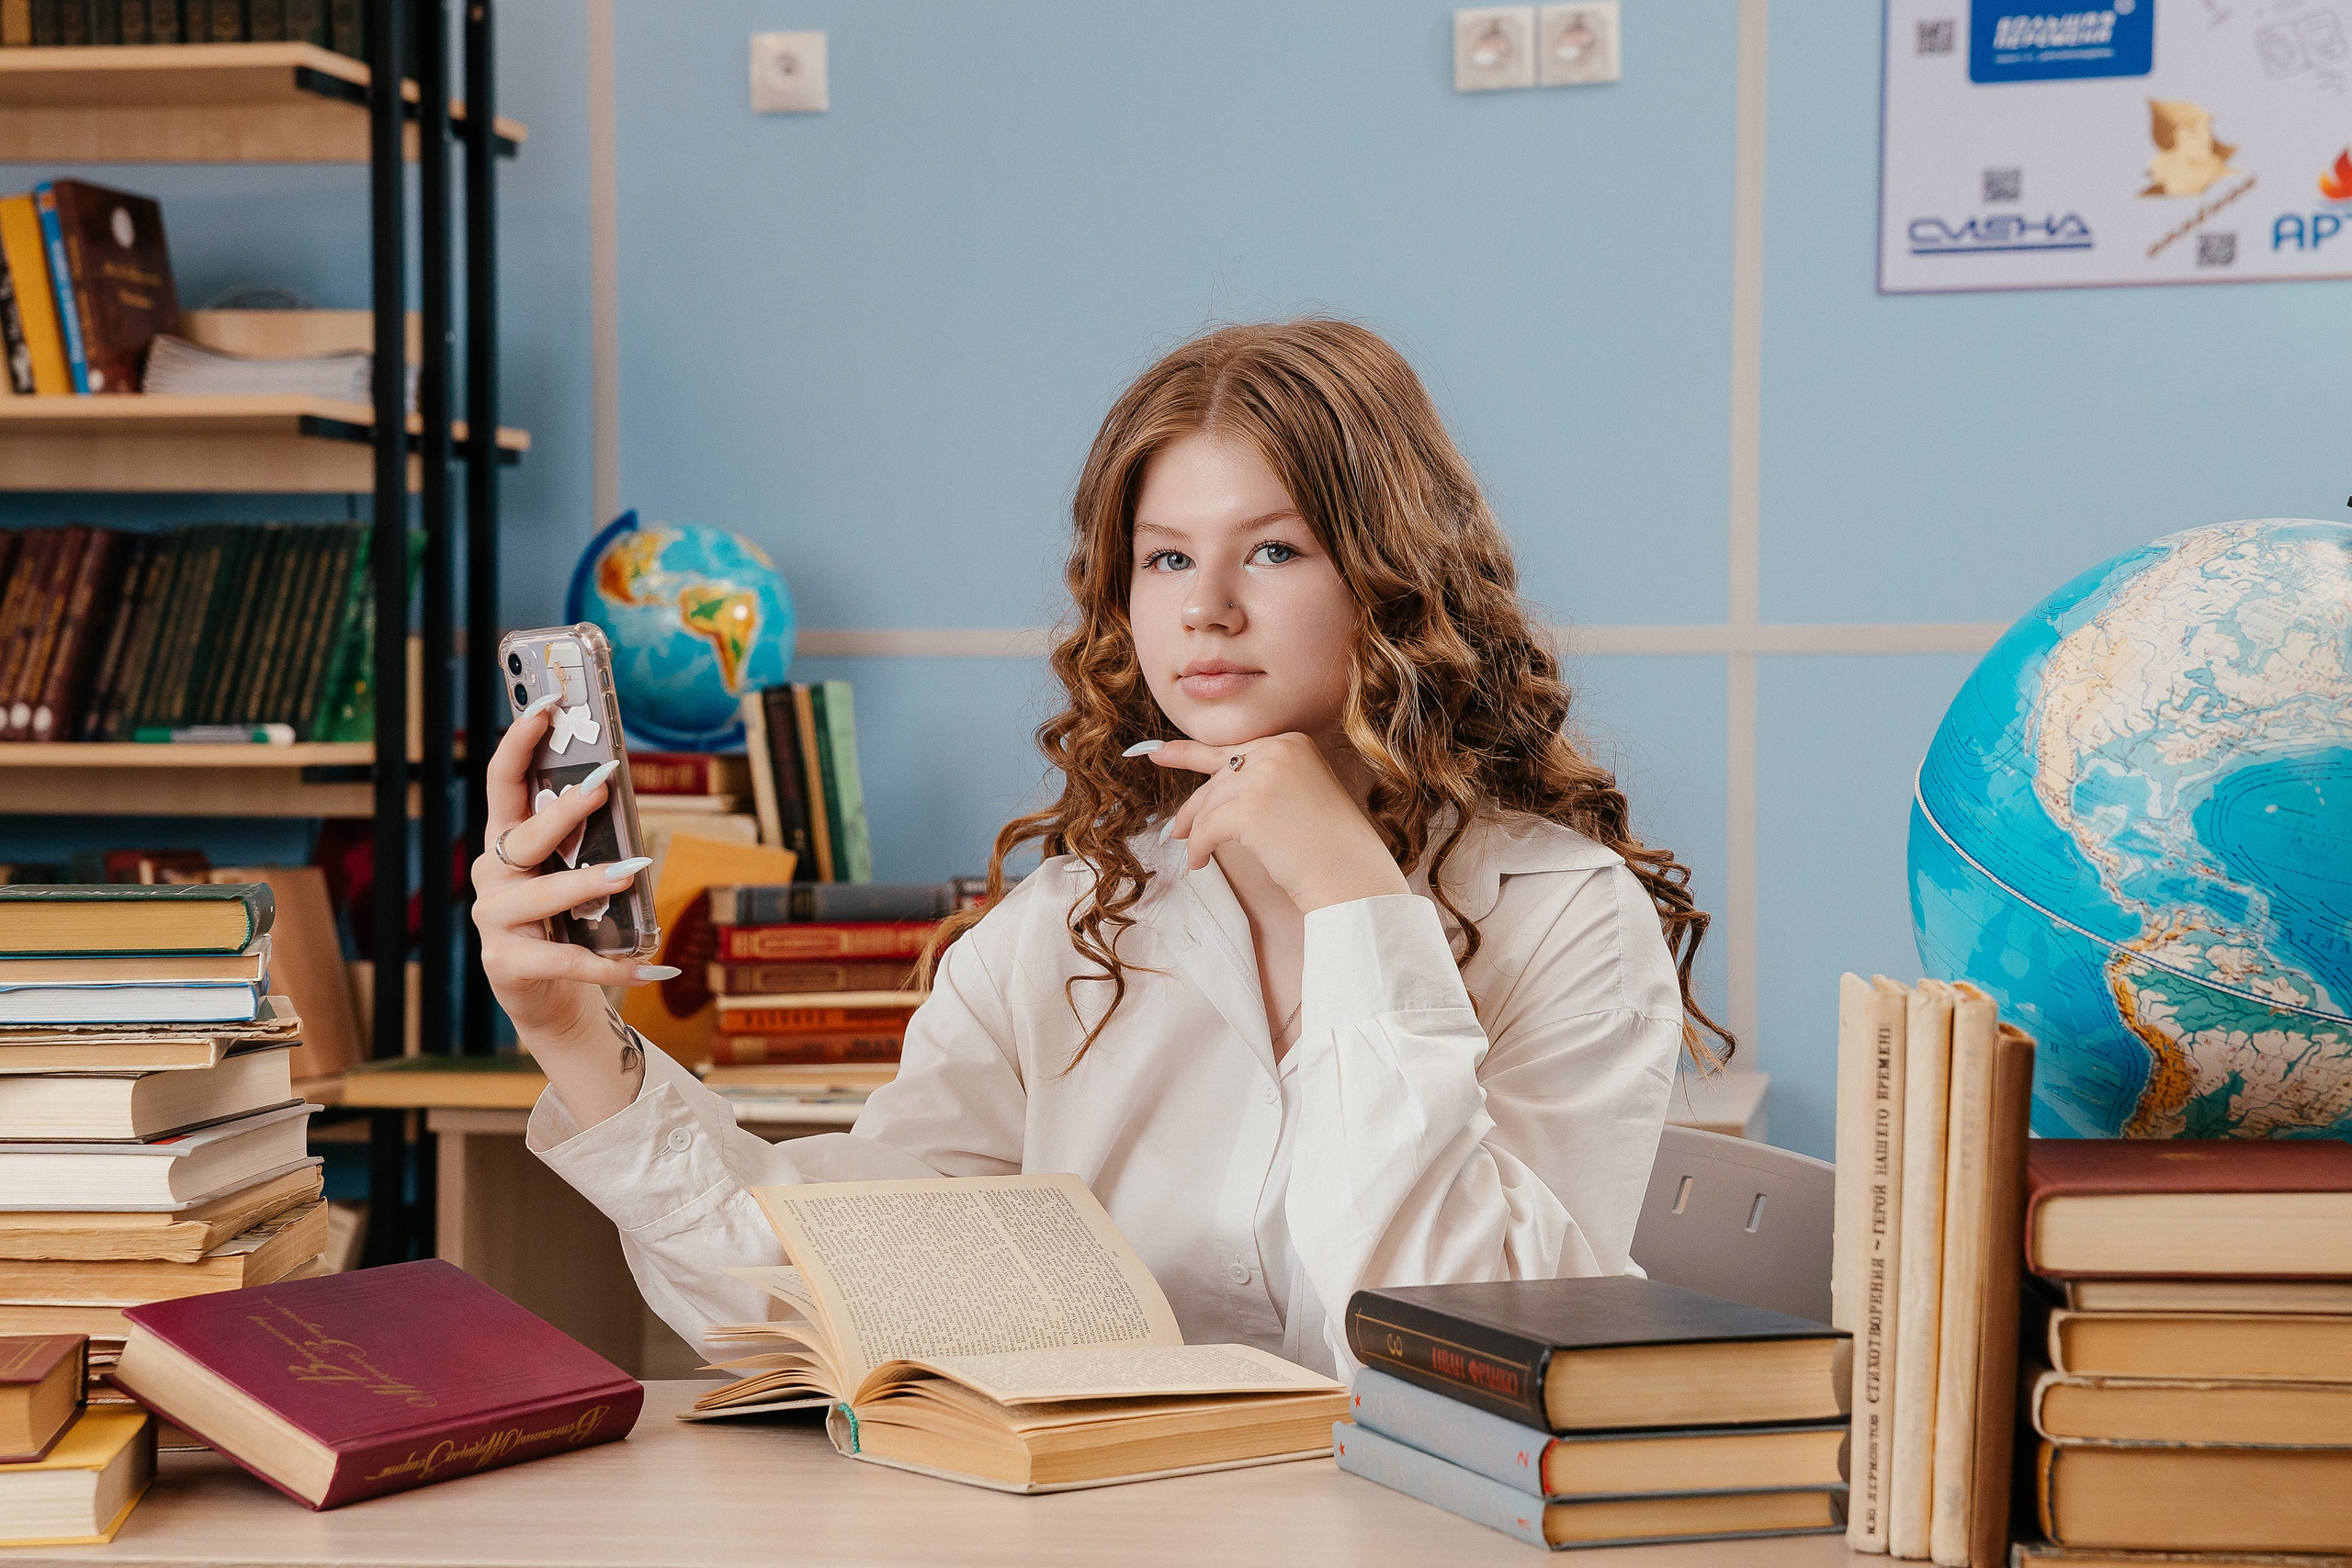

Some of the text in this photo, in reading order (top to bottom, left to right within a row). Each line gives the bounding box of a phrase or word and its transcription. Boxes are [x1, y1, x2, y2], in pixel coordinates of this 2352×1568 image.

[1873, 1110, 1889, 1175] НАШЕГО
[1871, 1185, 1886, 1235] ГЕРОЙ
[1865, 1258, 1883, 1404] СТИХОТВОРЕНИЯ
[1430, 1346, 1465, 1379] ИВАН
